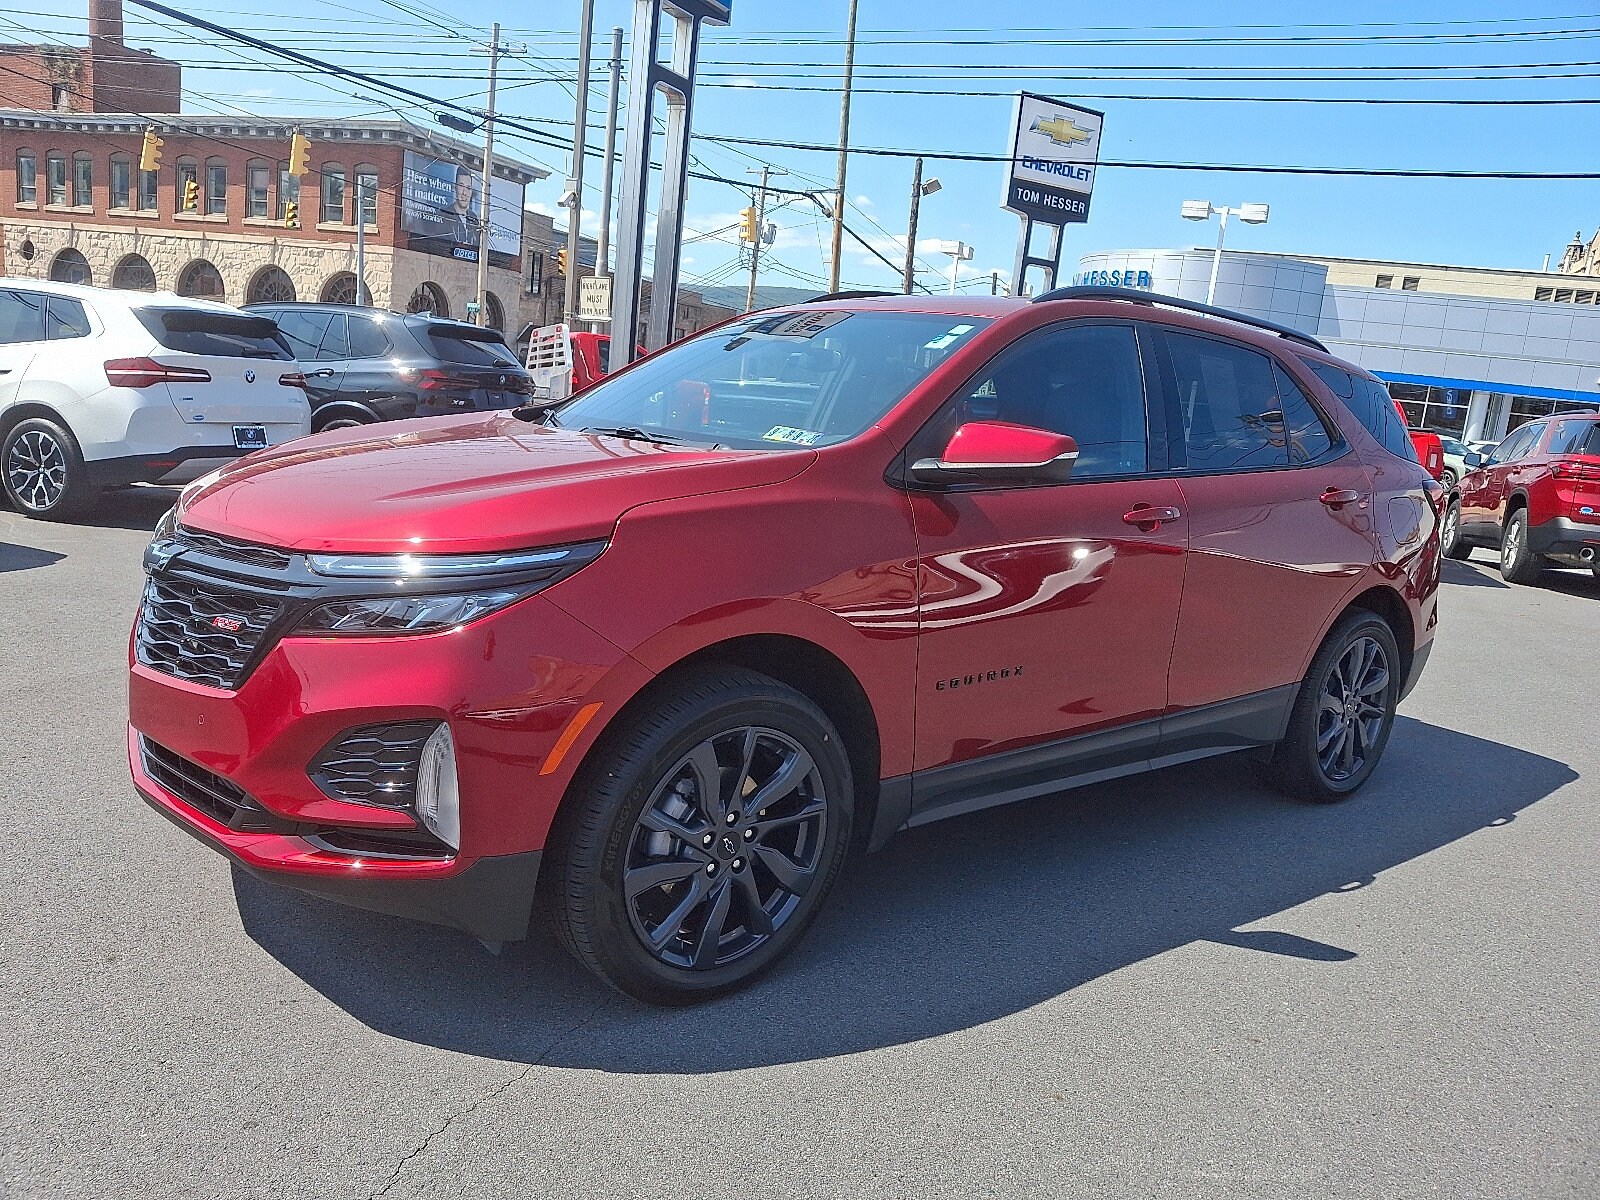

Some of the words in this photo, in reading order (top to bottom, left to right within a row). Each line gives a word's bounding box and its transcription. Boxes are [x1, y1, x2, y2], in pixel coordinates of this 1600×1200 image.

[406, 169, 428, 186] Here
[429, 178, 452, 192] when
[1022, 155, 1091, 181] CHEVROLET
[406, 184, 412, 197] it
[1017, 188, 1040, 203] TOM
[1043, 194, 1085, 213] HESSER
[935, 666, 1023, 691] EQUINOX
